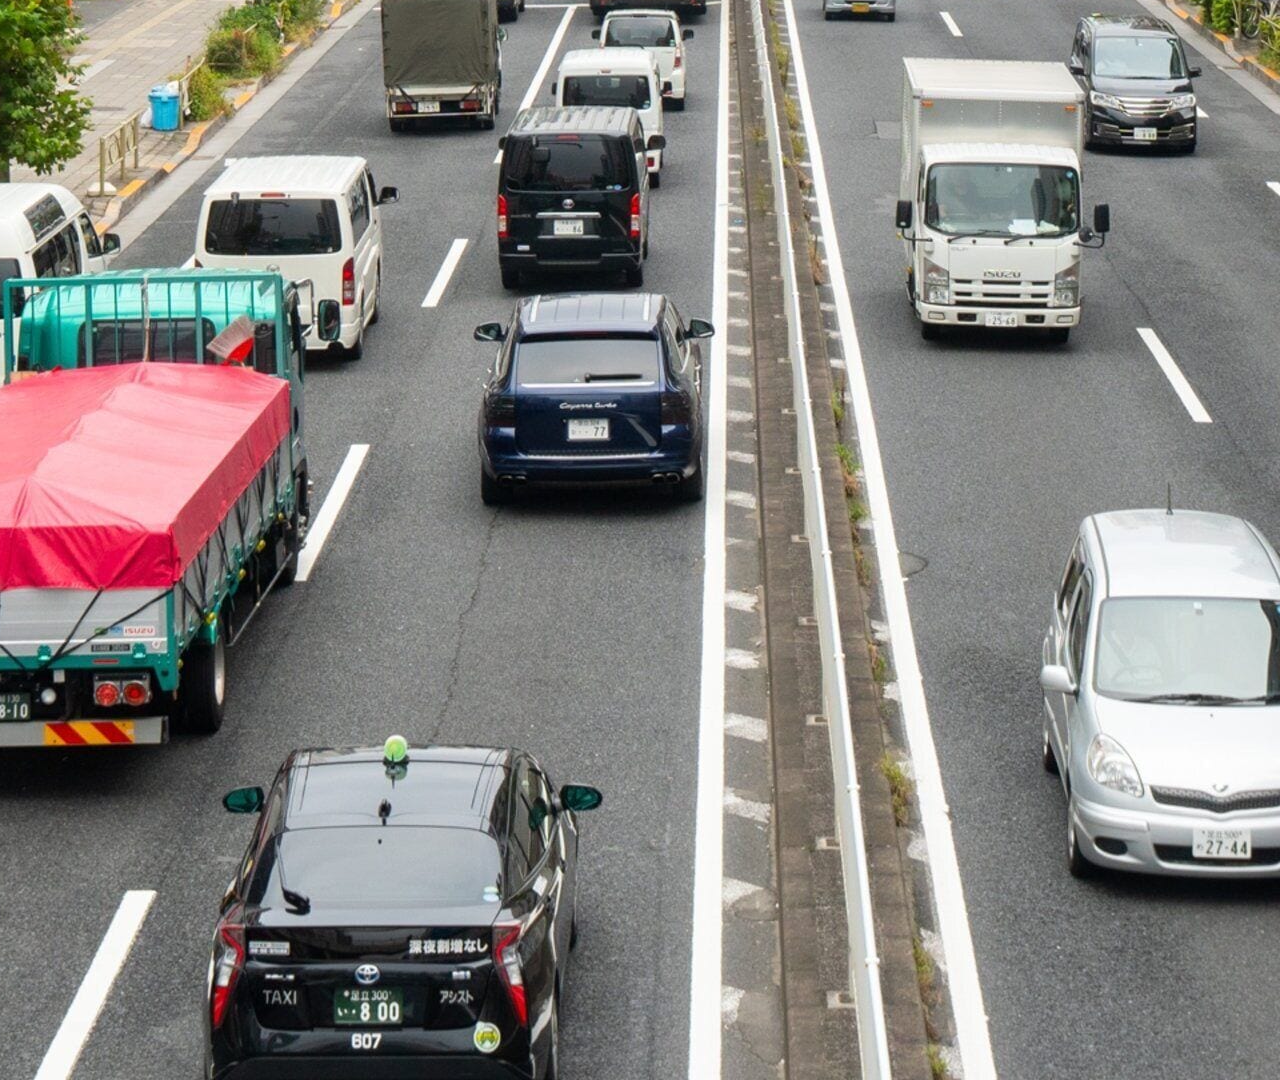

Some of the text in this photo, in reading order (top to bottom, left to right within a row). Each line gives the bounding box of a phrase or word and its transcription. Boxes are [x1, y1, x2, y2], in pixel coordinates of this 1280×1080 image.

[1206, 839, 1248, 855] 27-44
[409, 938, 488, 955] 深夜割増なし
[263, 989, 297, 1005] TAXI
[439, 990, 474, 1005] アシスト
[351, 1033, 381, 1049] 607
